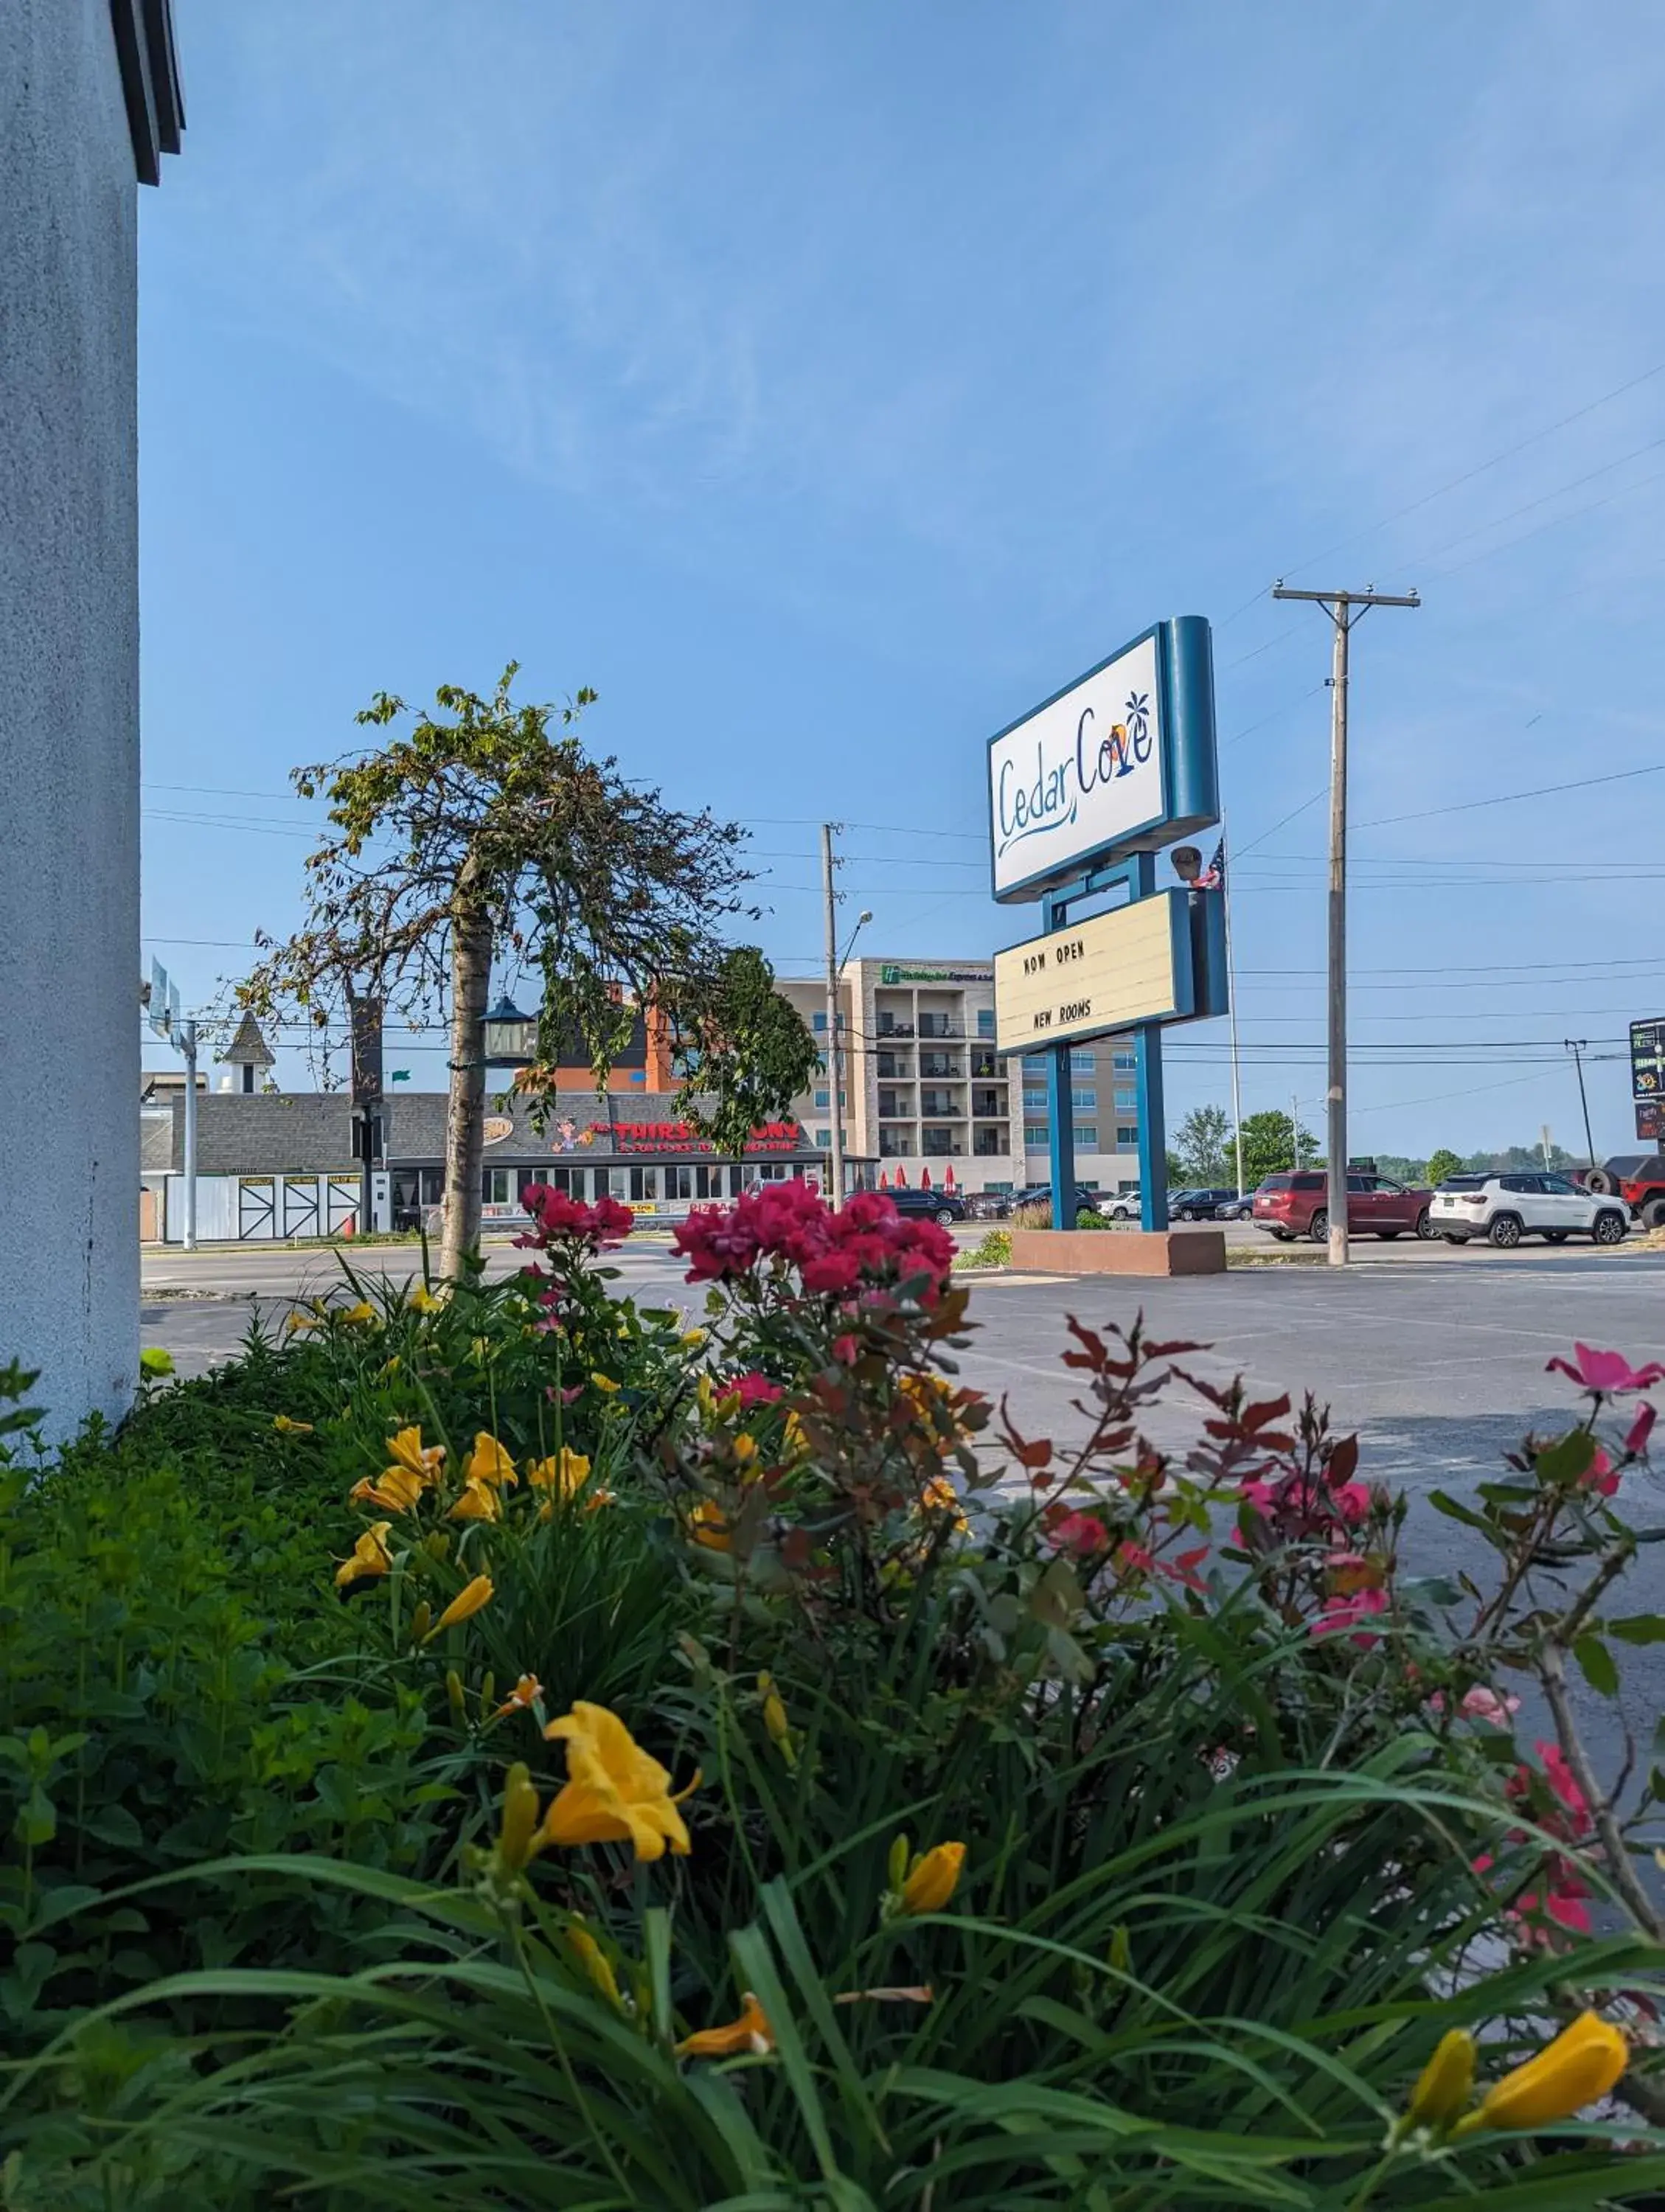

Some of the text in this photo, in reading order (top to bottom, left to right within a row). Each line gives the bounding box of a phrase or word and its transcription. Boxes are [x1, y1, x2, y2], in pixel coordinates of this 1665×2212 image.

[1000, 707, 1153, 837] Cedar Cove
[1023, 940, 1085, 975] NOW OPEN
[1034, 999, 1091, 1029] NEW ROOMS
[613, 1121, 699, 1141] THIRS
[690, 1203, 729, 1214] PIZA
